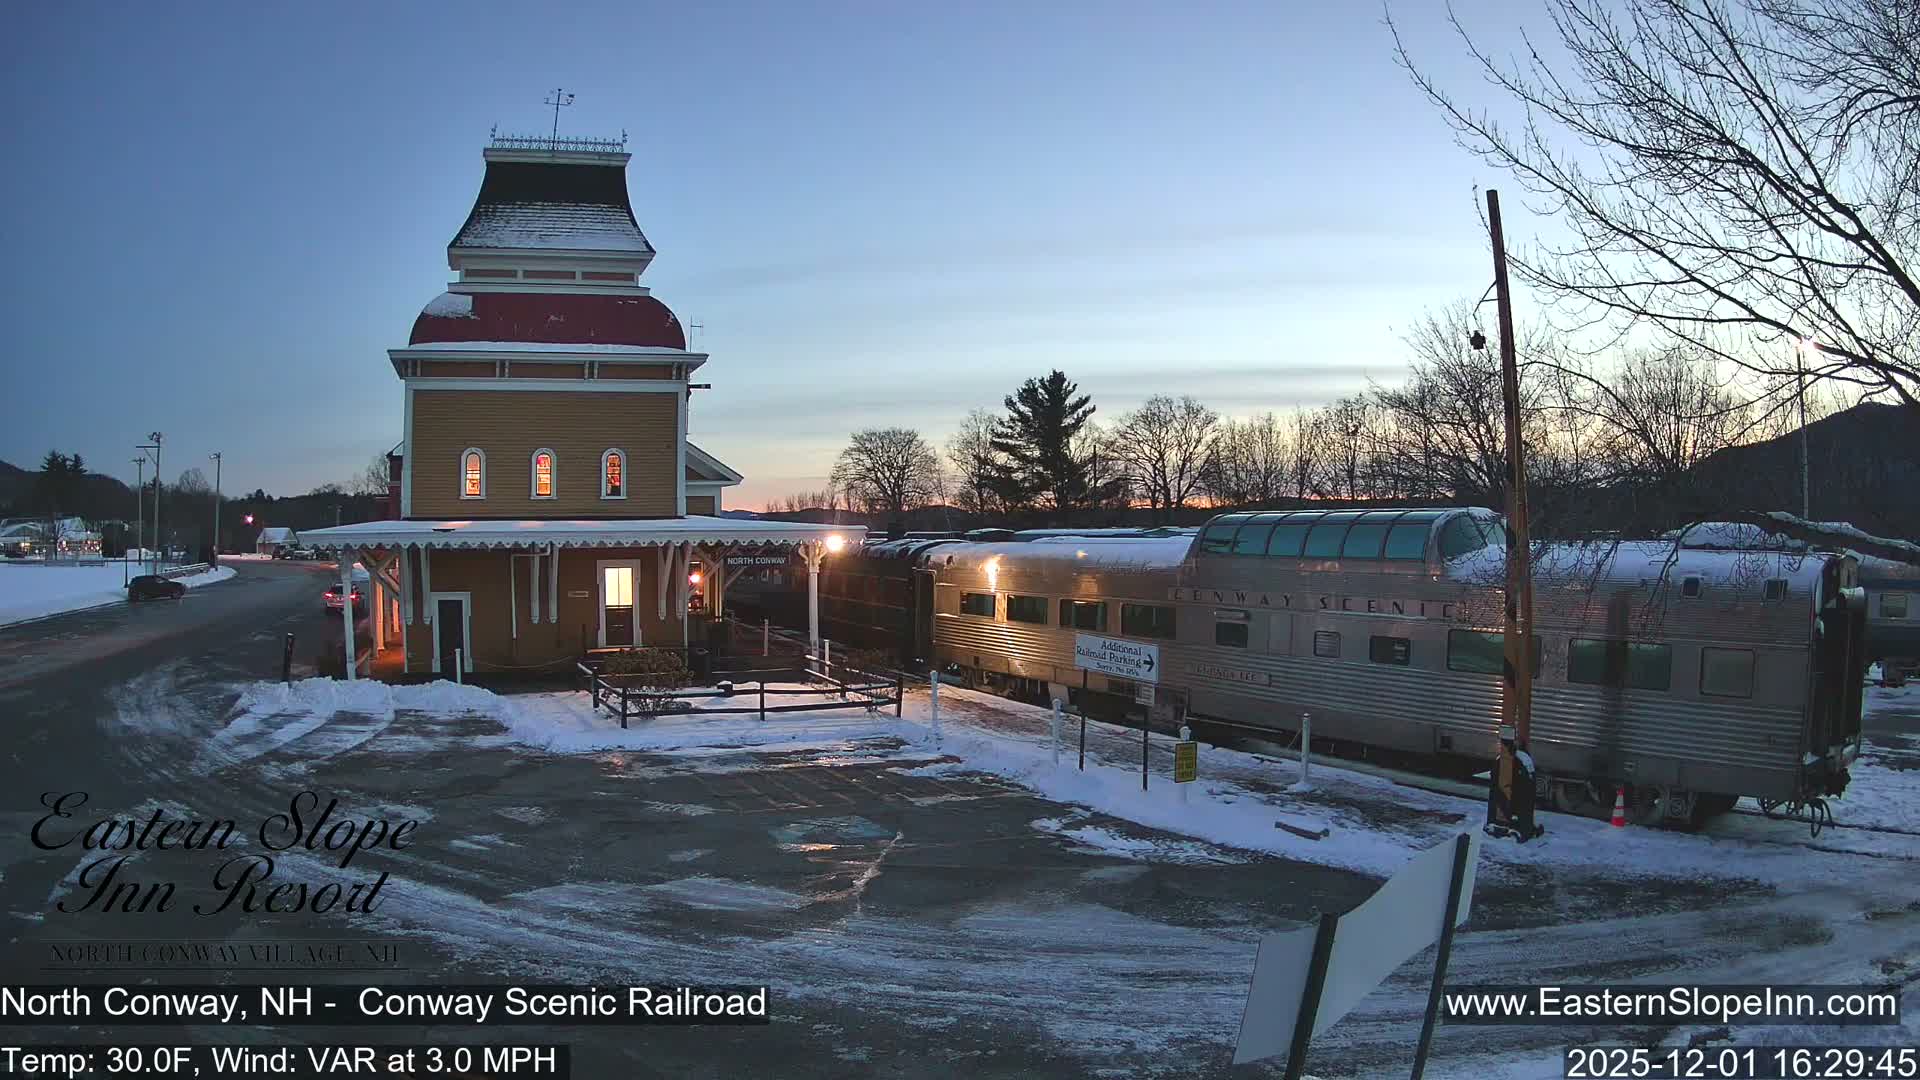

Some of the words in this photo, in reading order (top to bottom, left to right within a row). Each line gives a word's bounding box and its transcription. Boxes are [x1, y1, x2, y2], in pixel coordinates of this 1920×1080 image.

[727, 556, 754, 565] NORTH
[755, 556, 786, 565] CONWAY
[1320, 595, 1453, 618] SCENIC
[1076, 645, 1107, 660] Railroad
[1109, 652, 1142, 668] Parking
[1101, 640, 1142, 656] Additional
